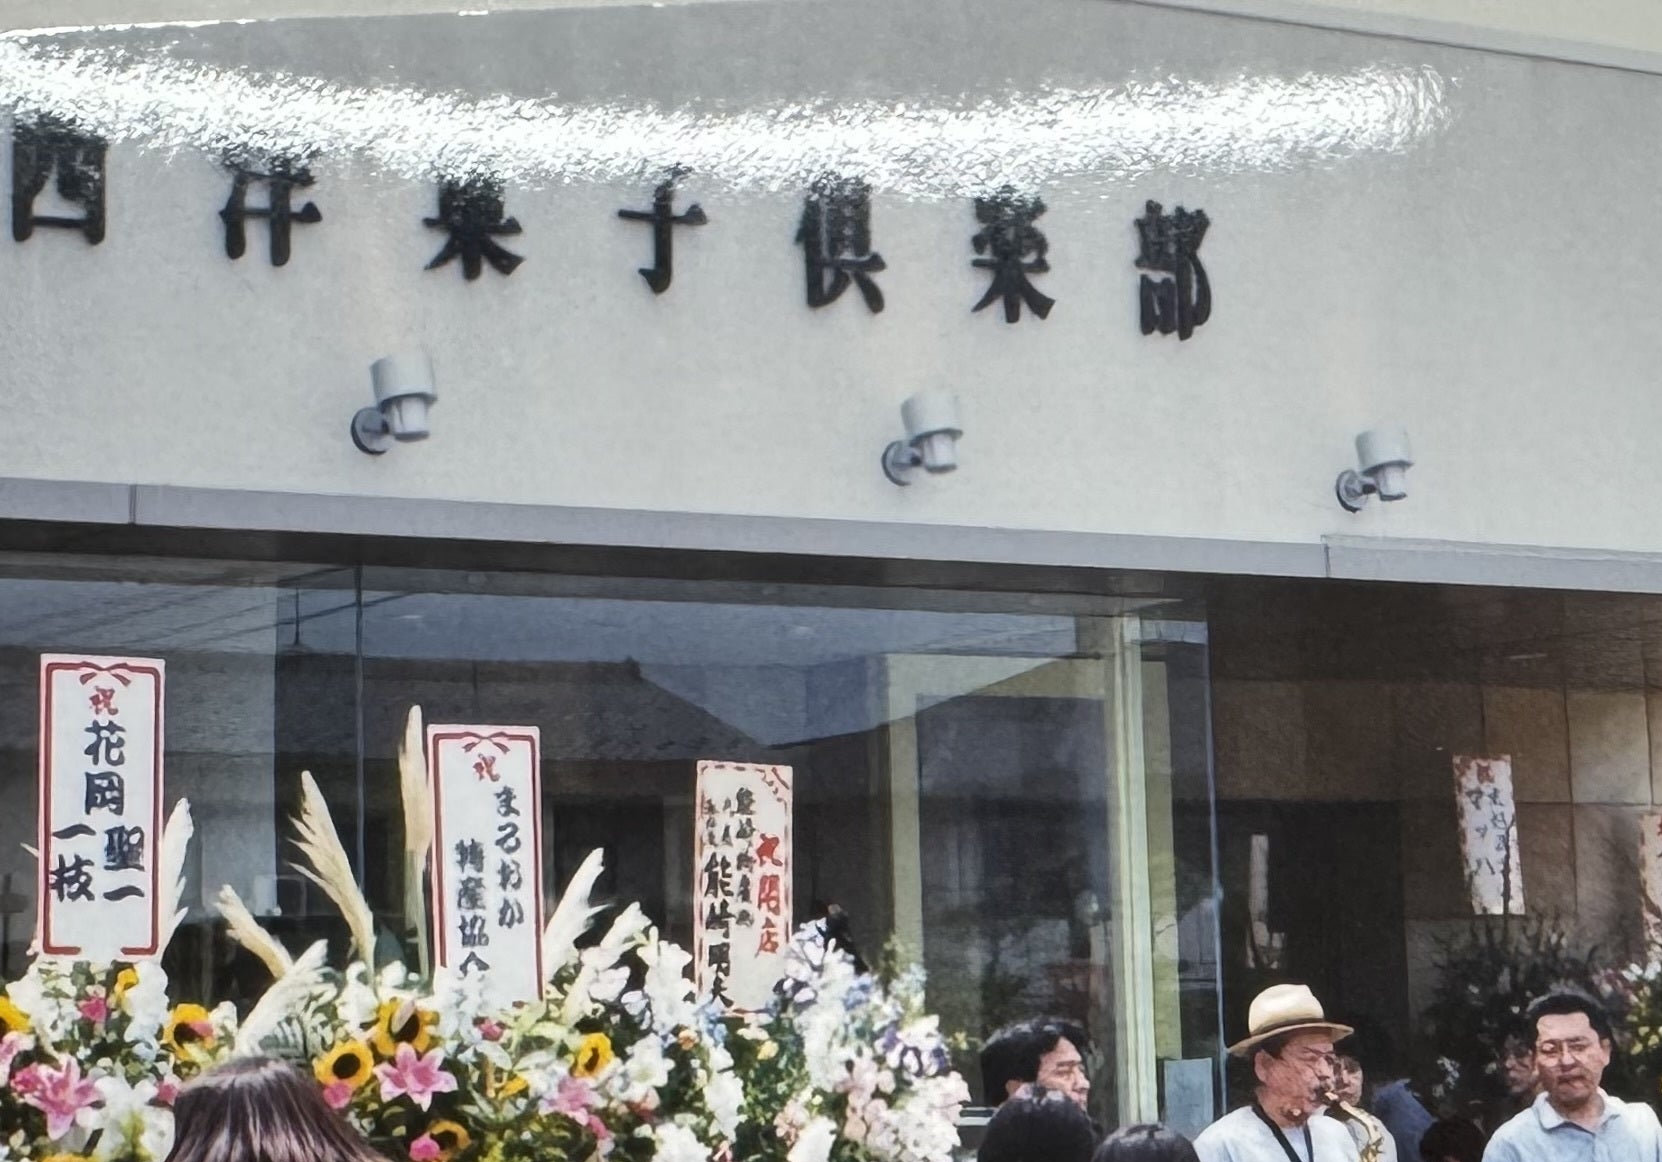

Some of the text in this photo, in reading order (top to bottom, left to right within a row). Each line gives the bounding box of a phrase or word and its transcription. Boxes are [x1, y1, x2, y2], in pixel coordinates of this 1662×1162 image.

[84, 720, 127, 816] 花岡
[494, 785, 525, 929] まるおか
